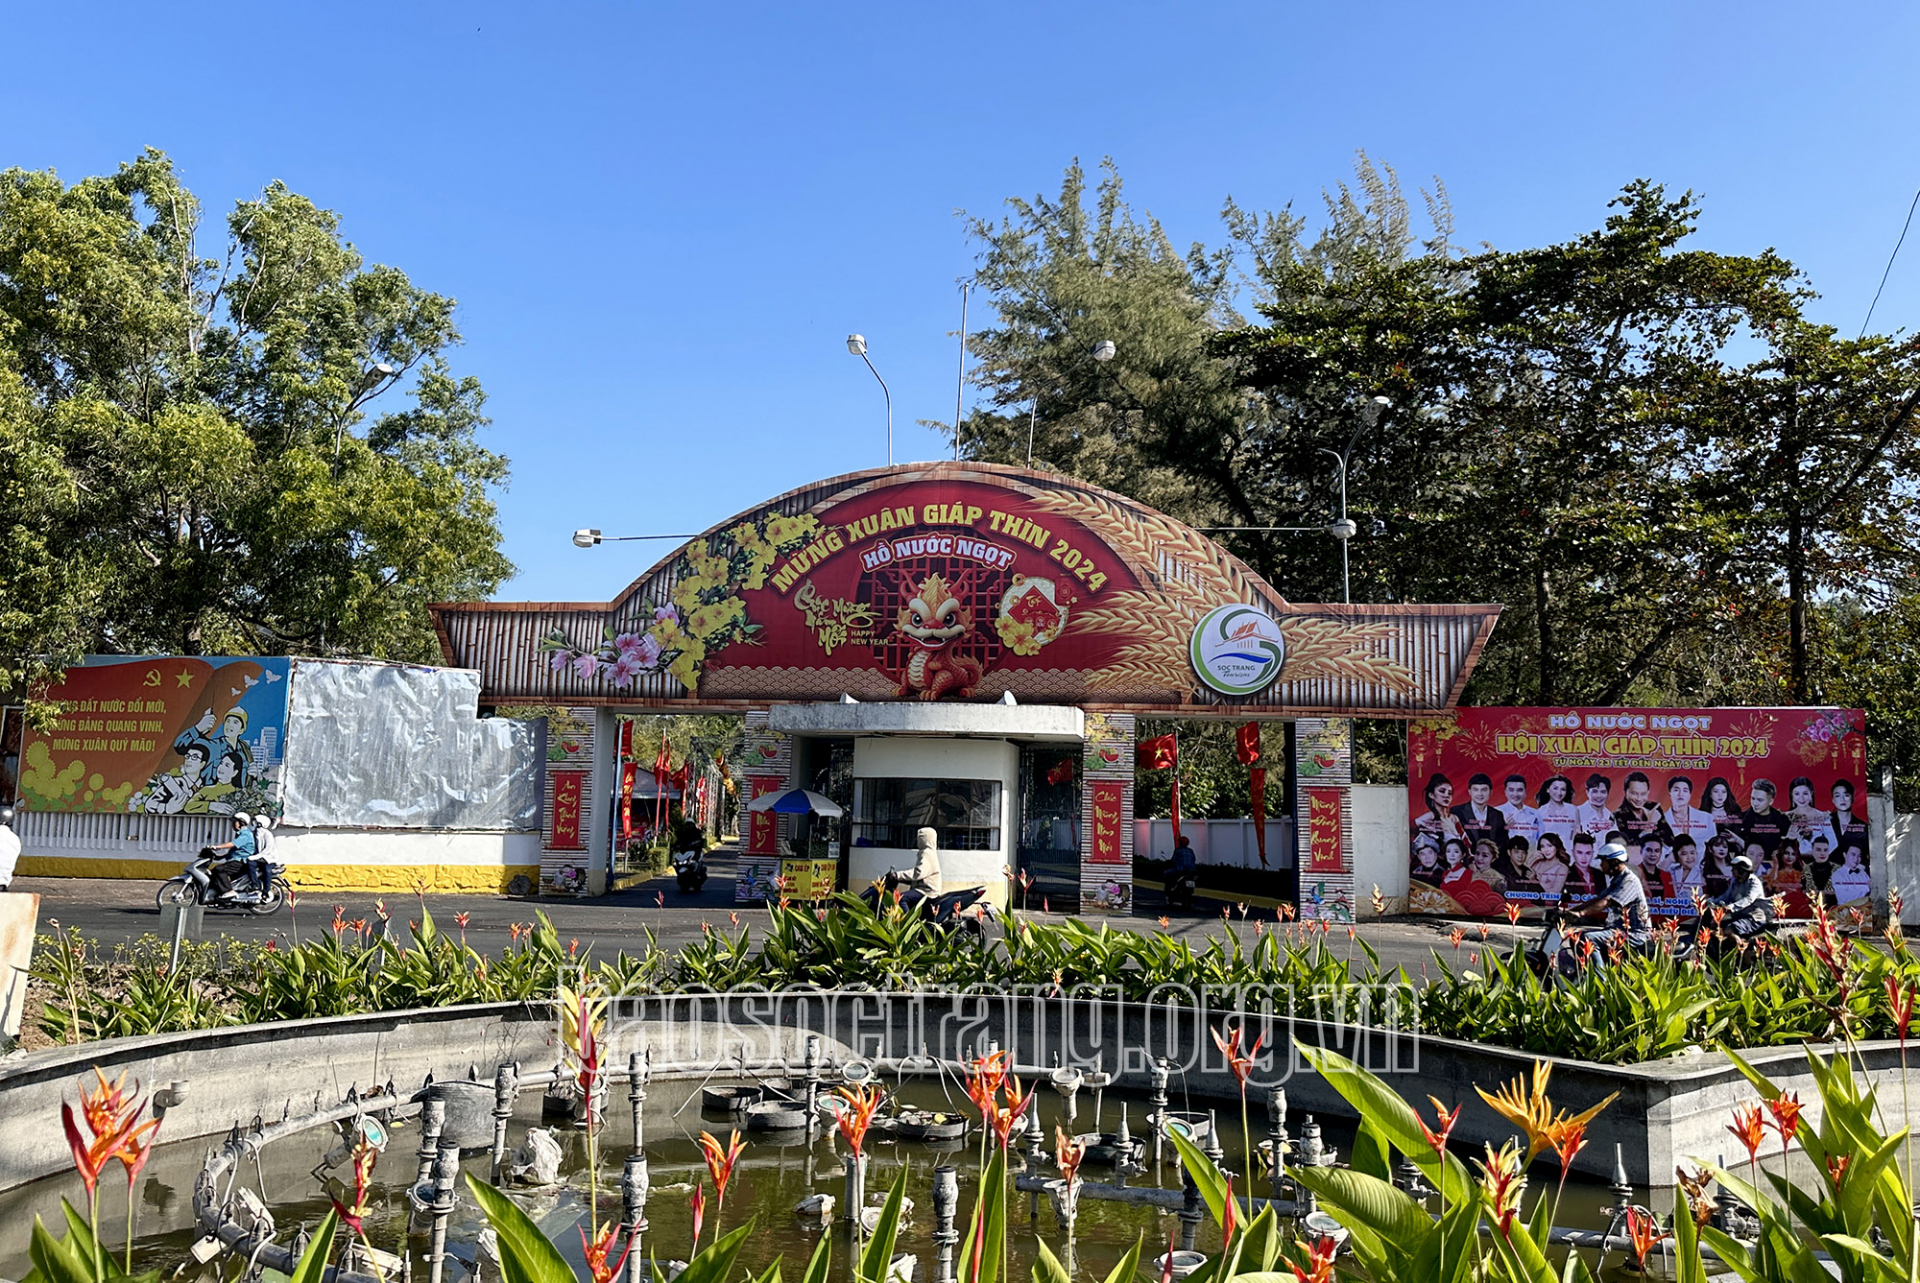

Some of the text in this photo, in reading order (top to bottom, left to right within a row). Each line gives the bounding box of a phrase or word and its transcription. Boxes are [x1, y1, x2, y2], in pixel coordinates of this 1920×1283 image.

[771, 501, 1107, 593] MỪNG XUÂN GIÁP THÌN 2024
[863, 534, 1012, 569] HỒ NƯỚC NGỌT
[80, 697, 98, 712] ĐẤT
[101, 700, 126, 713] NƯỚC
[128, 697, 143, 713] ĐỔI
[146, 700, 167, 714] MỚI,
[50, 717, 164, 733] ỪNG ĐẢNG QUANG VINH,
[1587, 713, 1645, 728] NƯỚC
[1651, 716, 1711, 732] NGỌT
[53, 737, 156, 752] MỪNG XUÂN QUÝ MÃO!
[1497, 732, 1768, 757] HỘI XUÂN GIÁP THÌN 2024
[1569, 758, 1595, 766] NGÀY
[1613, 757, 1629, 767] TẾT
[1654, 758, 1681, 768] NGÀY
[1692, 759, 1709, 768] TẾT
